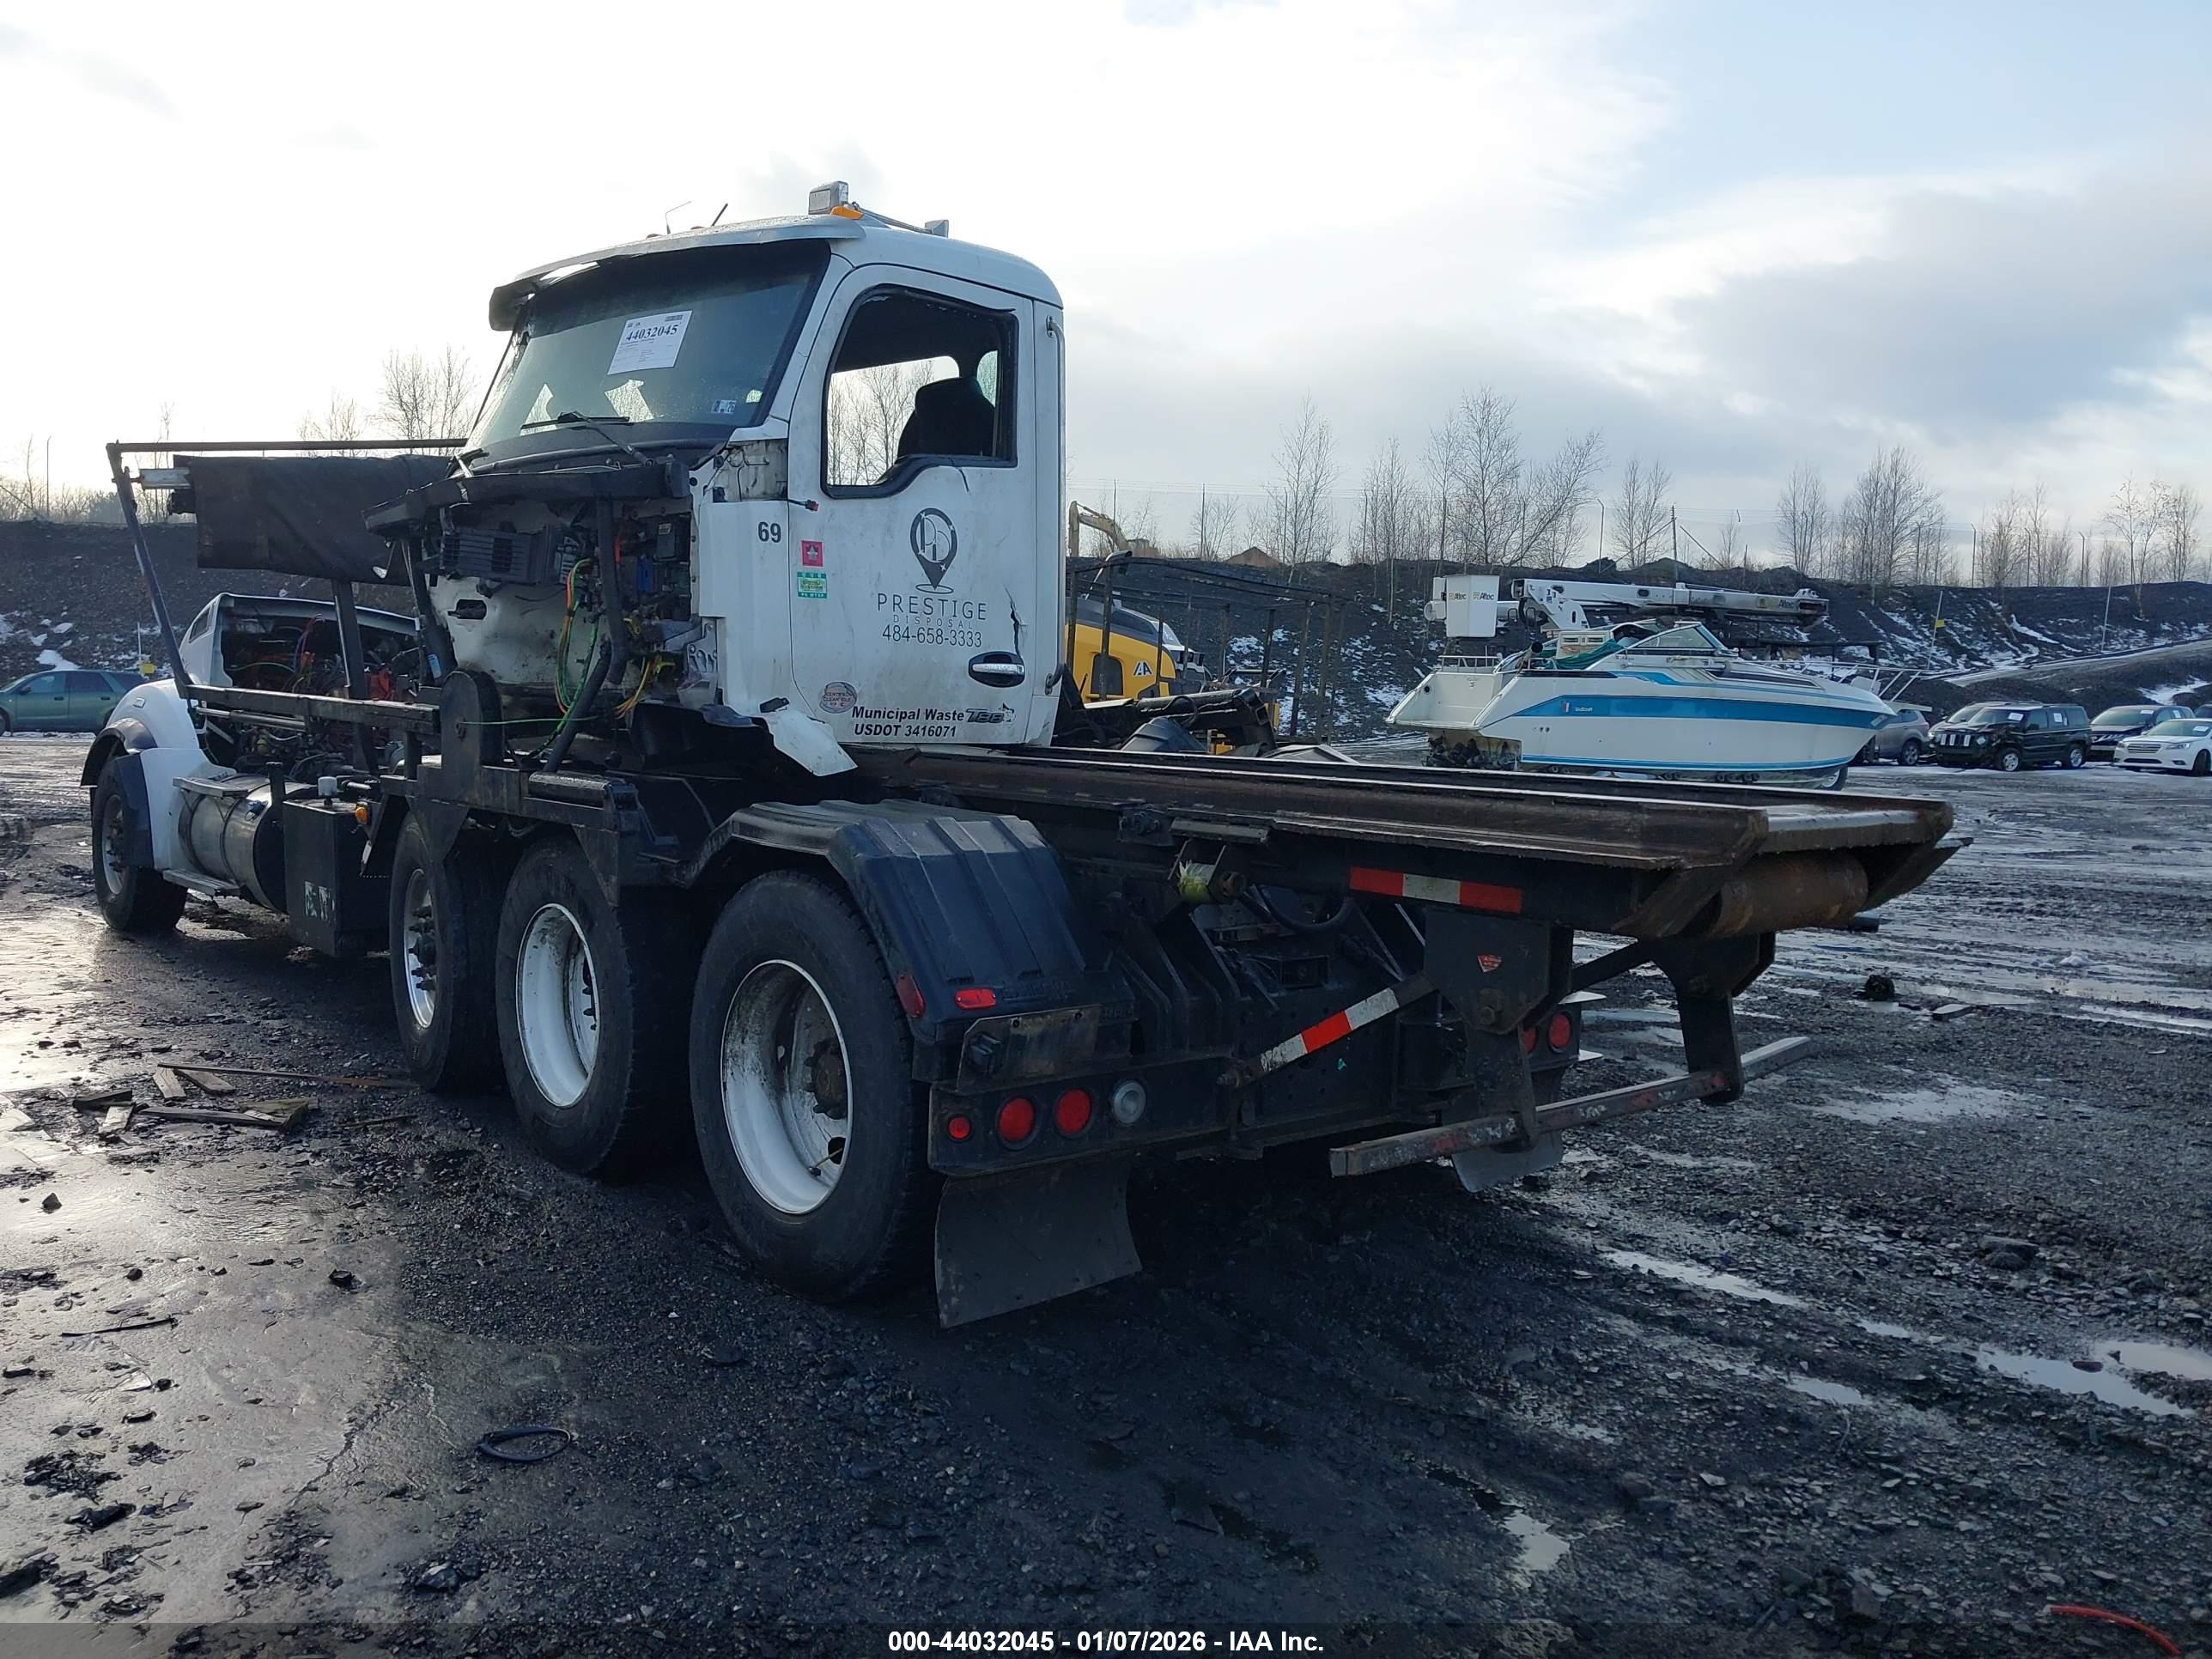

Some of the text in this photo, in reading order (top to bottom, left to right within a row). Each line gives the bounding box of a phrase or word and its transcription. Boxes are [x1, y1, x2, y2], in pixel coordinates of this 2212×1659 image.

[626, 324, 678, 342] 44032045
[757, 521, 782, 543] 69
[1480, 592, 1495, 600] Altec
[877, 592, 987, 620] PRESTIGE
[893, 614, 973, 629] DISPOSAL
[882, 624, 981, 647] 484-658-3333
[852, 706, 964, 722] Municipal Waste
[854, 723, 957, 738] USDOT 3416071
